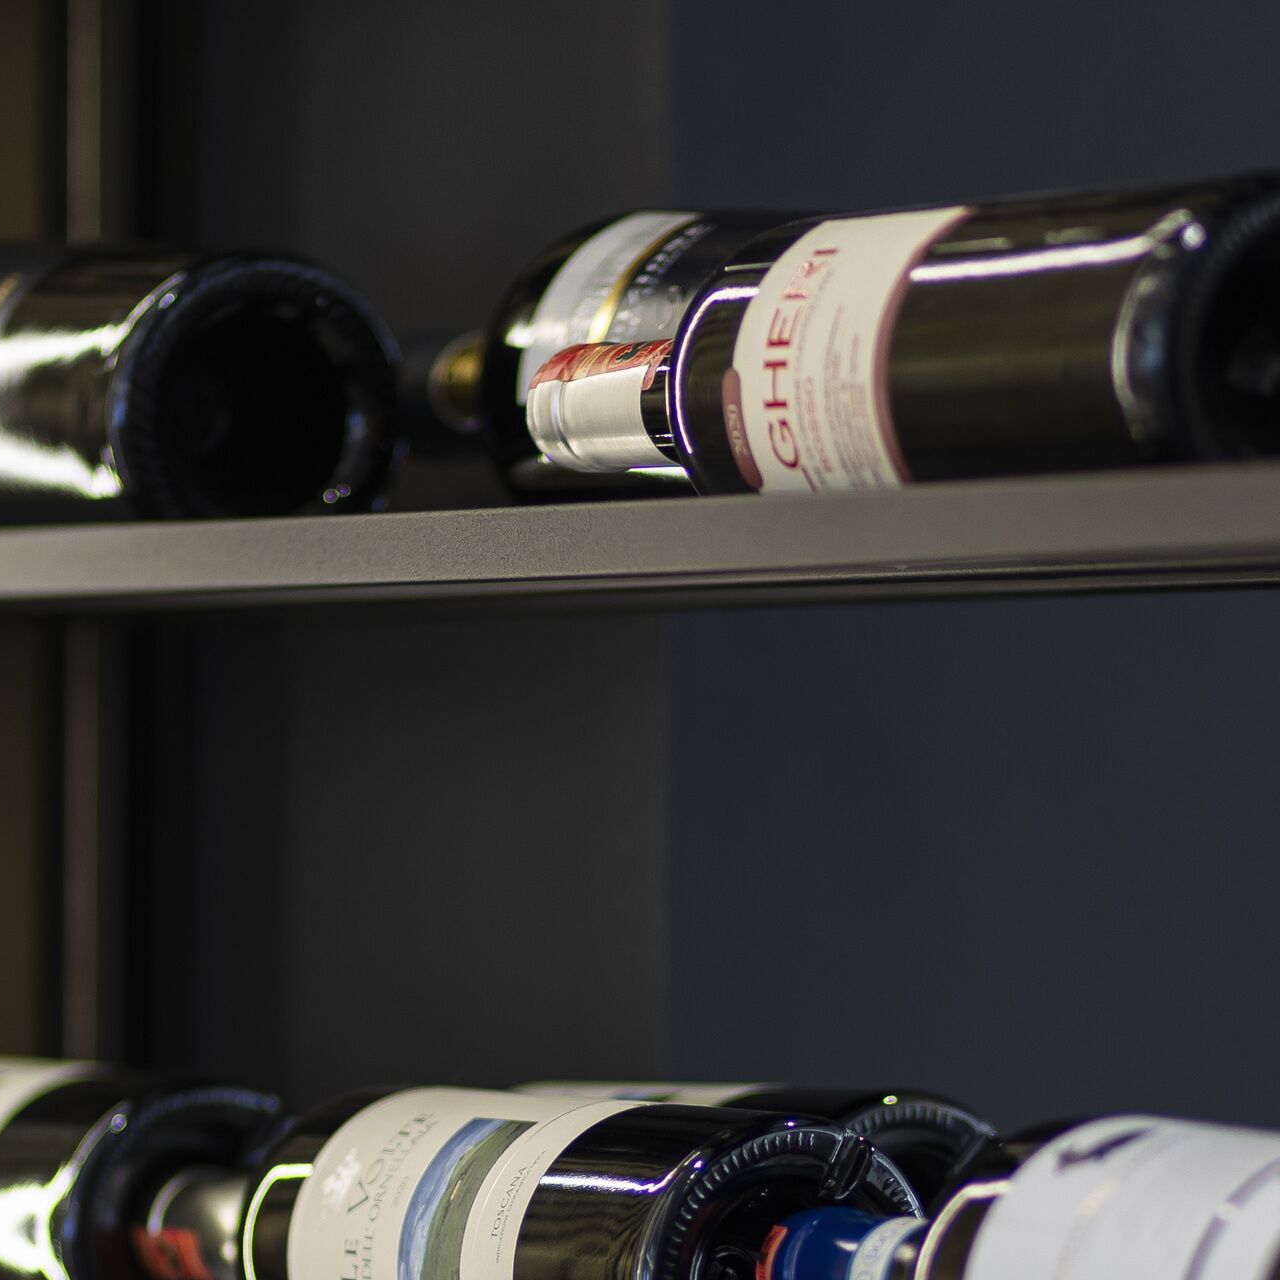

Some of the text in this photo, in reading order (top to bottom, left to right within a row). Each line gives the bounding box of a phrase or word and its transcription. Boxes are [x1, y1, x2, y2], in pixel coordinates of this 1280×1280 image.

[764, 247, 838, 493] GHERI
[346, 1113, 435, 1215] VOLTE
[490, 1166, 527, 1239] TOSCANA
